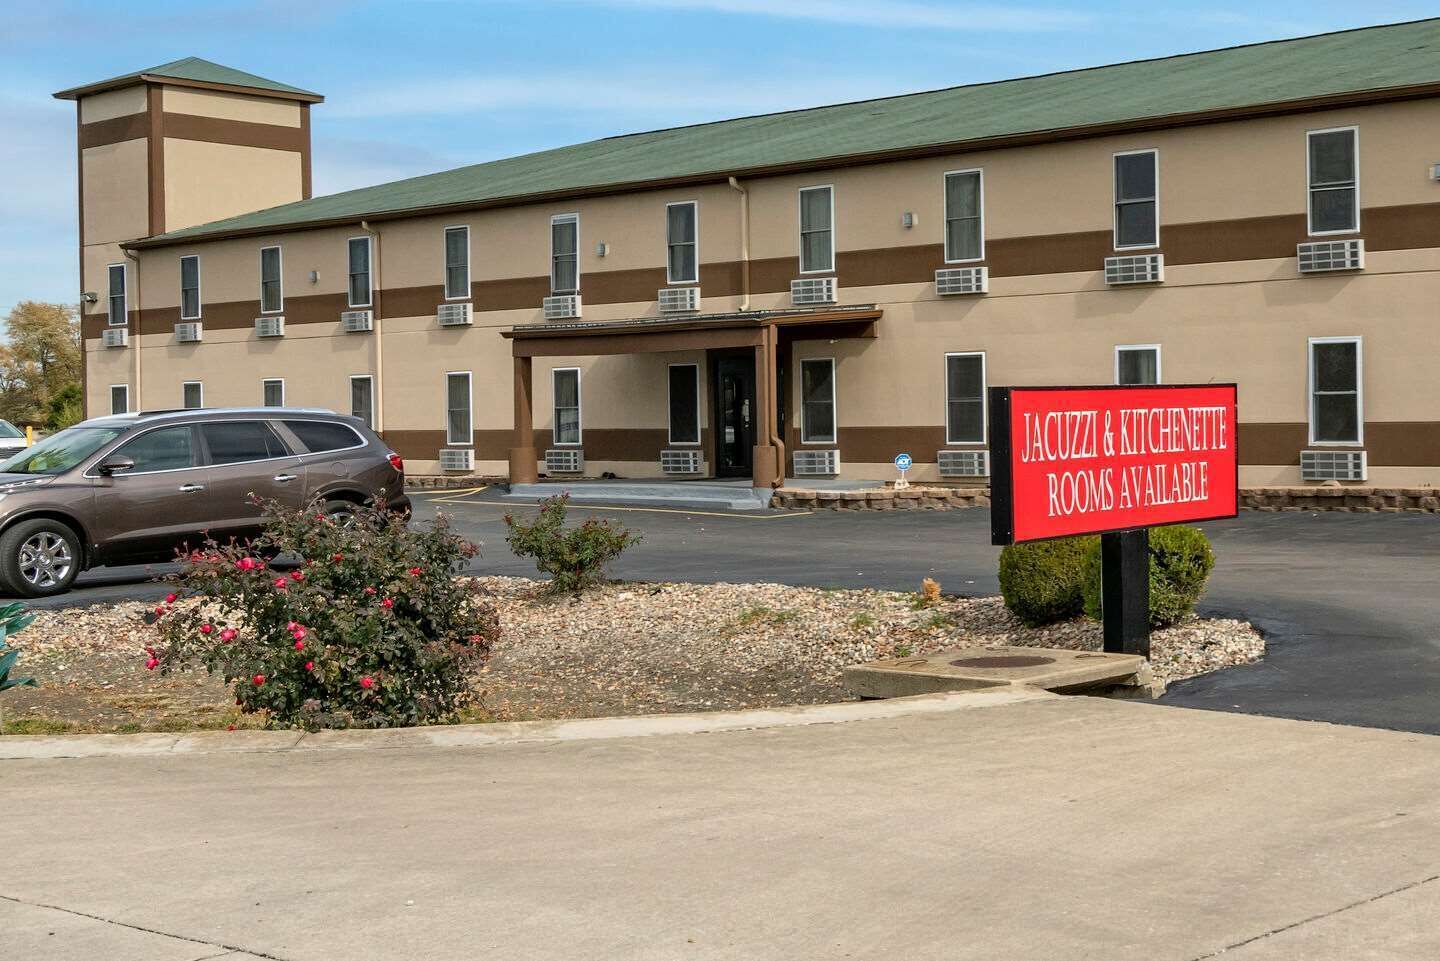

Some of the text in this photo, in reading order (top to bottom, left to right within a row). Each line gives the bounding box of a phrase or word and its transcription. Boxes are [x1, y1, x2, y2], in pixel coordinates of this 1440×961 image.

[1021, 406, 1227, 462] JACUZZI & KITCHENETTE
[1046, 461, 1209, 517] ROOMS AVAILABLE
